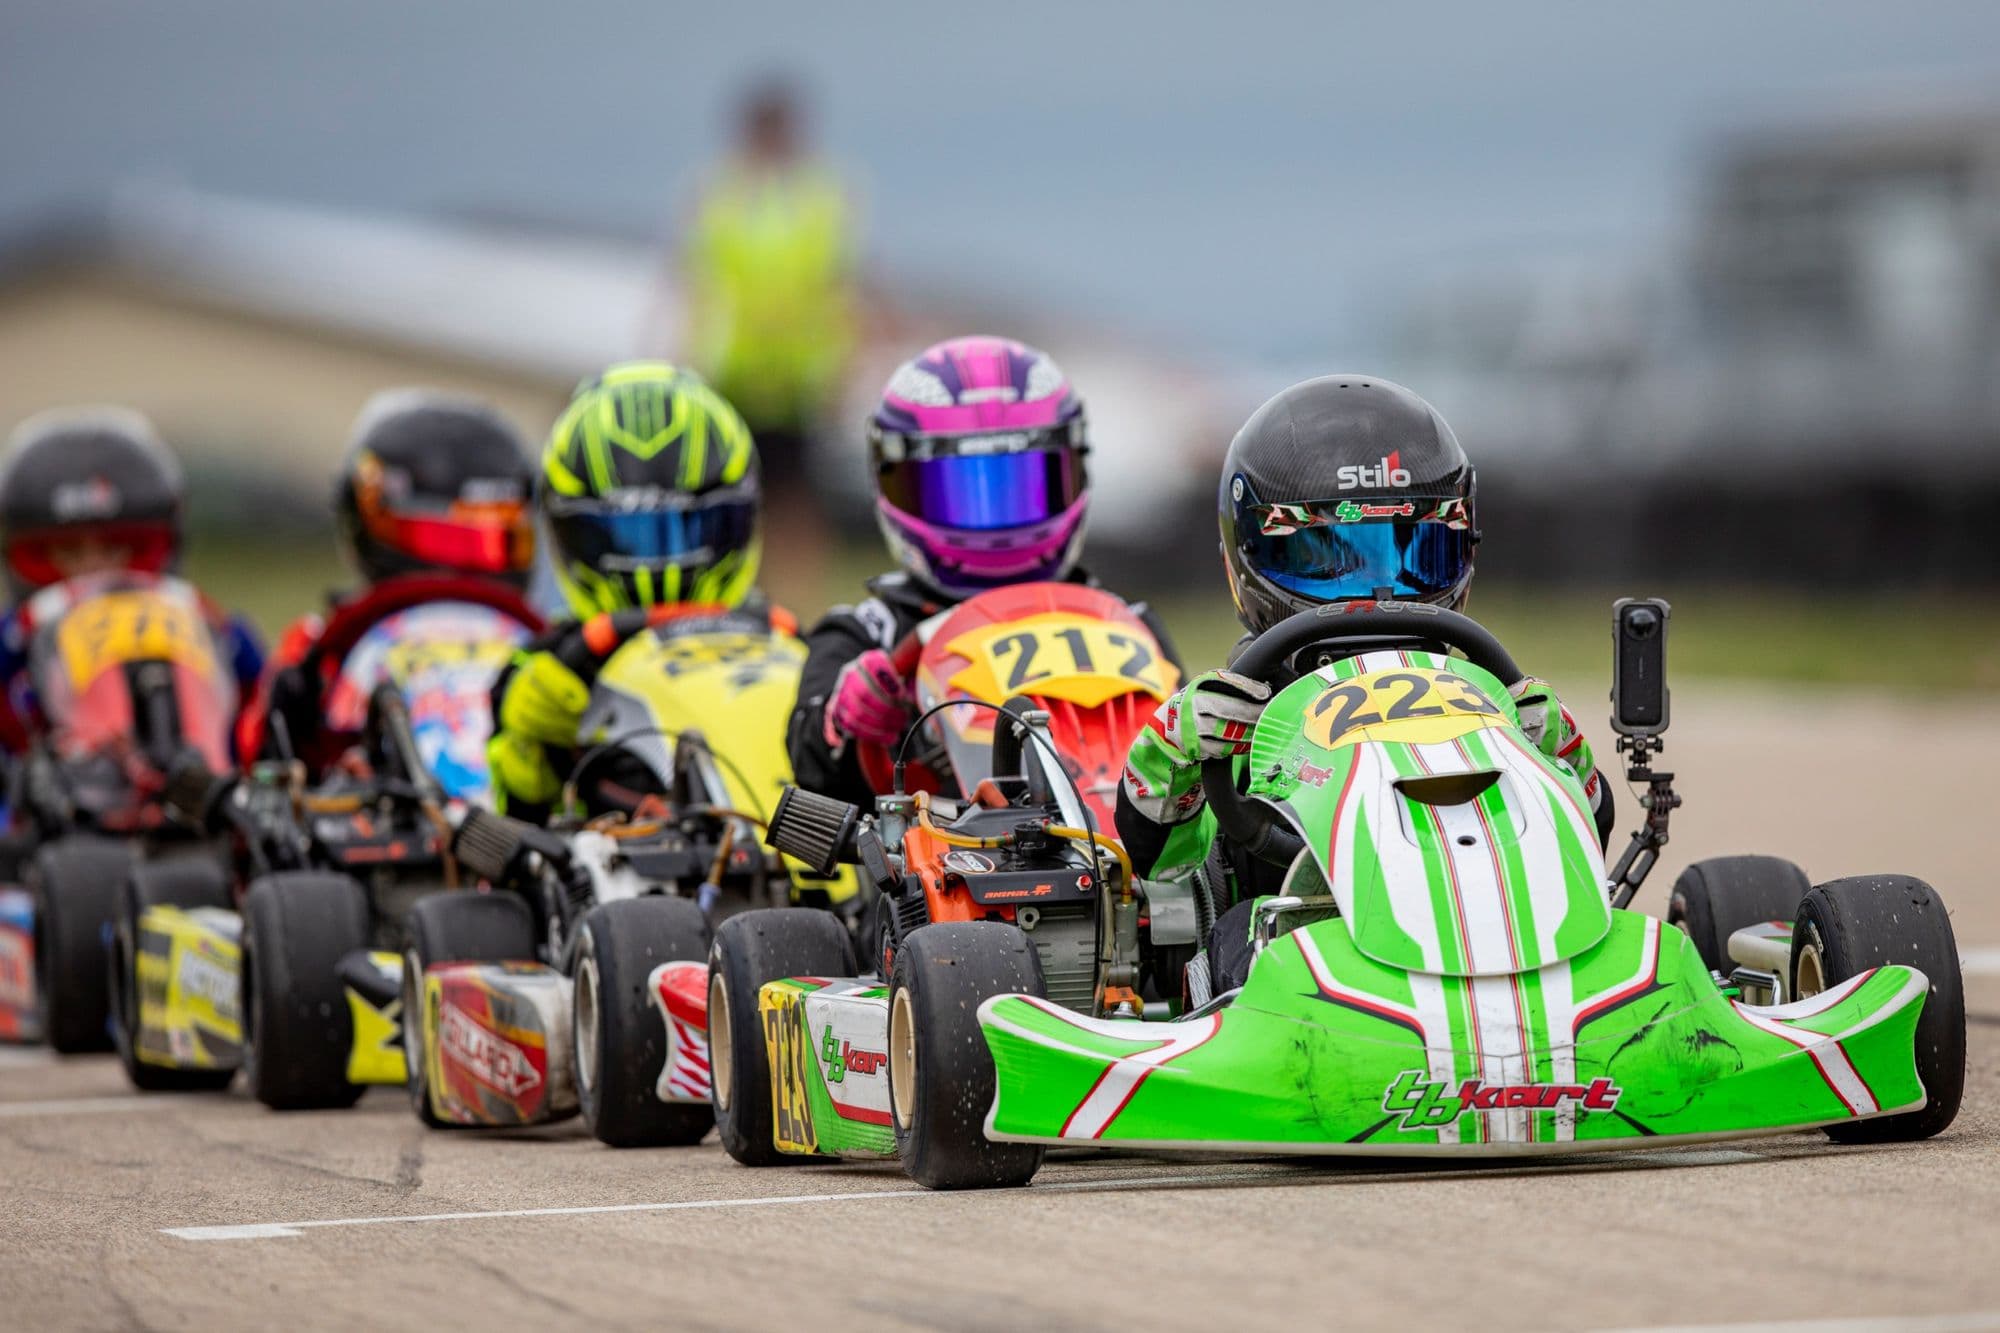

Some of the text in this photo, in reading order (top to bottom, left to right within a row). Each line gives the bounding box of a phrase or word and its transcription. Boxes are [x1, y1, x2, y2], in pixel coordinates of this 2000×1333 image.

[1336, 454, 1411, 490] Stilo
[992, 628, 1160, 690] 212
[1315, 673, 1501, 745] 223
[821, 1024, 889, 1084] tbkar
[1384, 1072, 1621, 1129] tbkart
